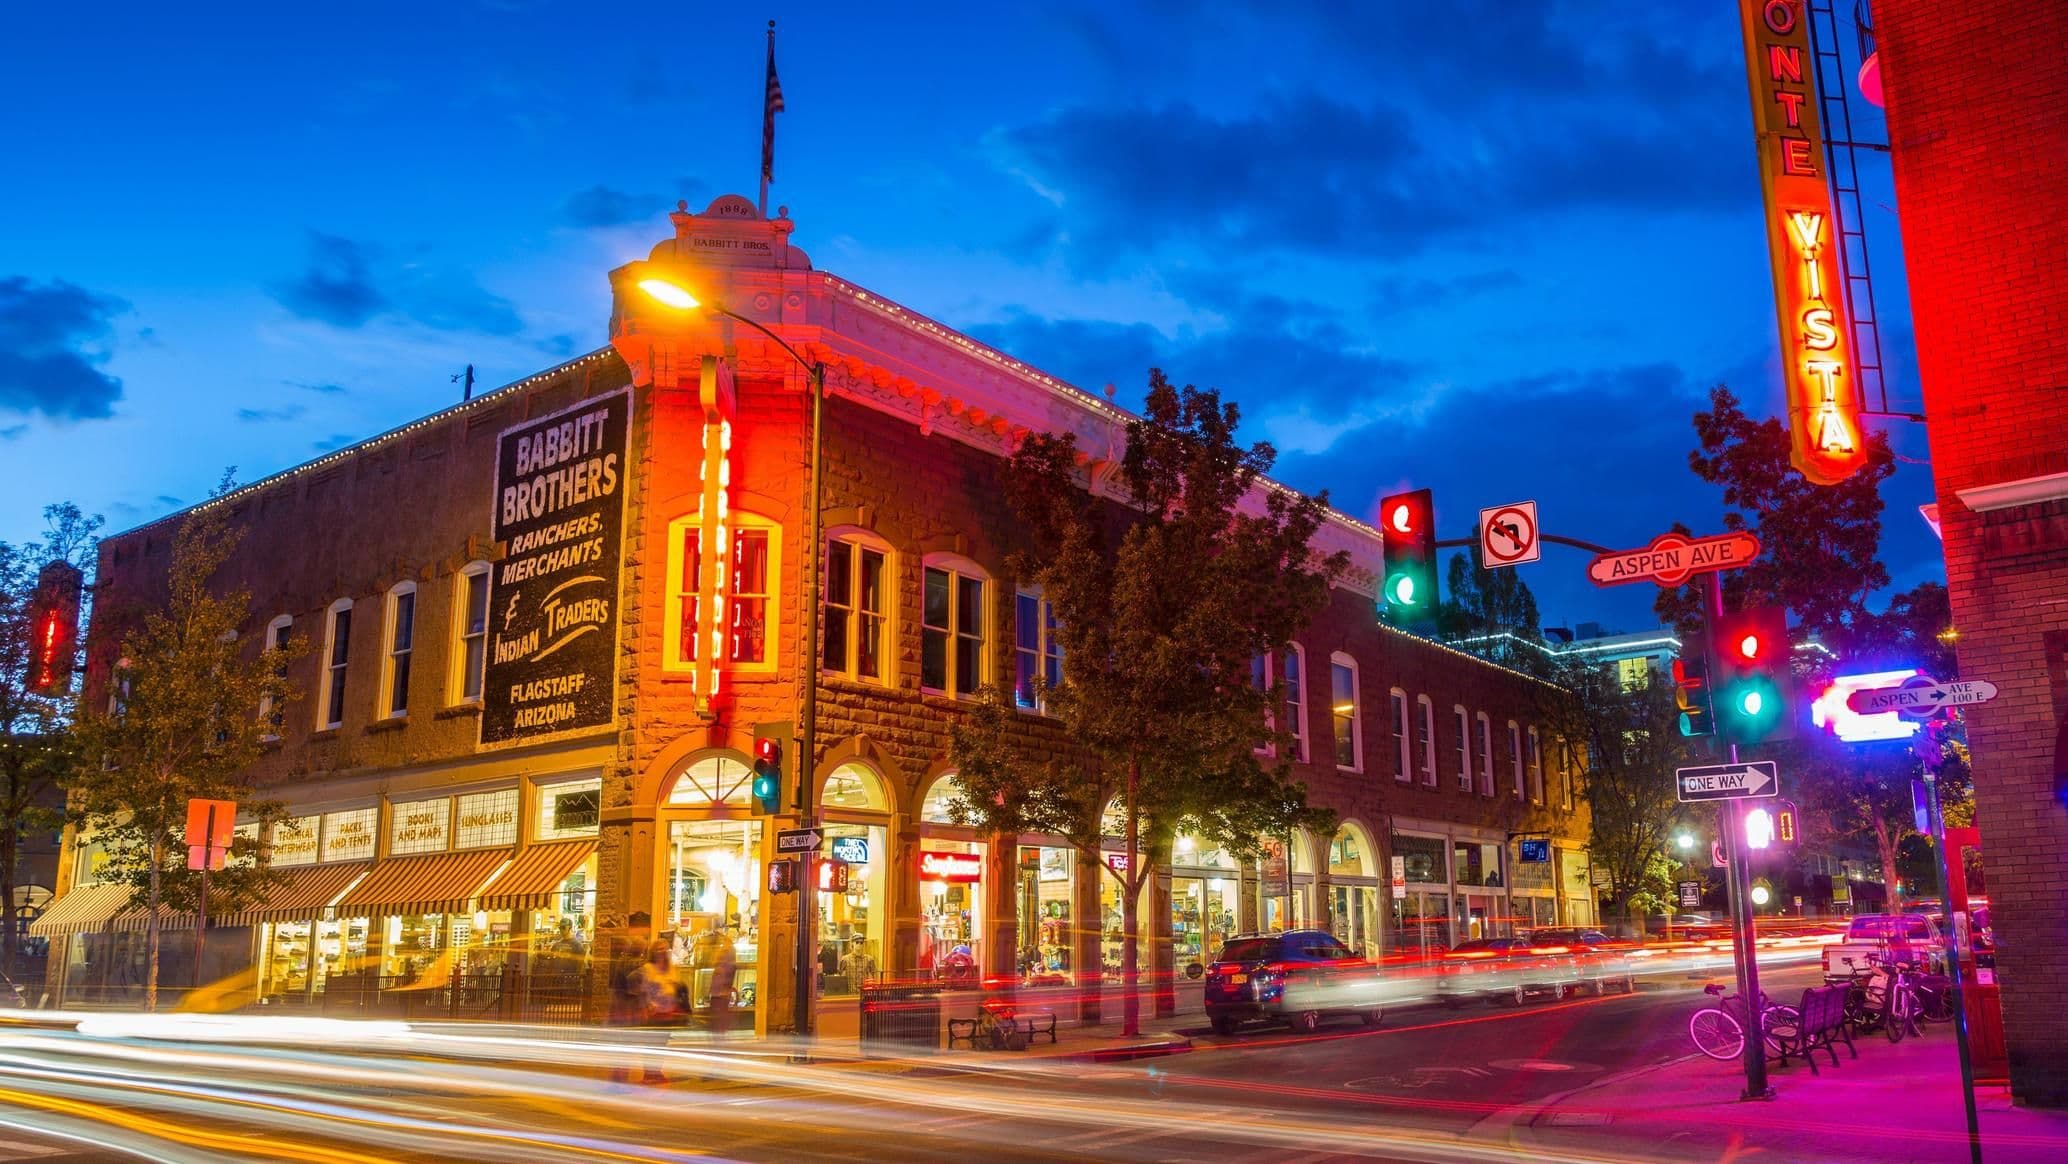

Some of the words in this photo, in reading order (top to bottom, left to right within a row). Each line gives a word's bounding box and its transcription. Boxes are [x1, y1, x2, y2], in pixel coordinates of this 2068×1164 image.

[694, 239, 739, 249] BABBITT
[743, 242, 771, 250] BROS.
[1786, 209, 1854, 454] VISTA
[515, 408, 610, 478] BABBITT
[502, 453, 618, 526] BROTHERS
[501, 538, 603, 586] MERCHANTS
[1611, 549, 1681, 577] ASPEN
[1689, 541, 1735, 565] AVE
[494, 628, 540, 665] INDIAN
[544, 598, 609, 639] TRADERS
[510, 673, 586, 704] FLAGSTAFF
[1870, 692, 1919, 709] ASPEN
[1949, 683, 1973, 694] AVE
[1952, 694, 1972, 704] 100
[1976, 692, 1985, 701] E
[514, 702, 576, 729] ARIZONA
[1688, 777, 1716, 791] ONE
[1718, 774, 1746, 789] WAY
[340, 822, 362, 834] PACKS
[407, 813, 434, 827] BOOKS
[461, 811, 513, 828] SUNGLASSES
[329, 838, 347, 850] AND
[349, 834, 371, 847] TENTS
[398, 830, 416, 841] AND
[419, 826, 442, 839] MAPS
[781, 836, 796, 847] ONE
[796, 834, 809, 845] WAY
